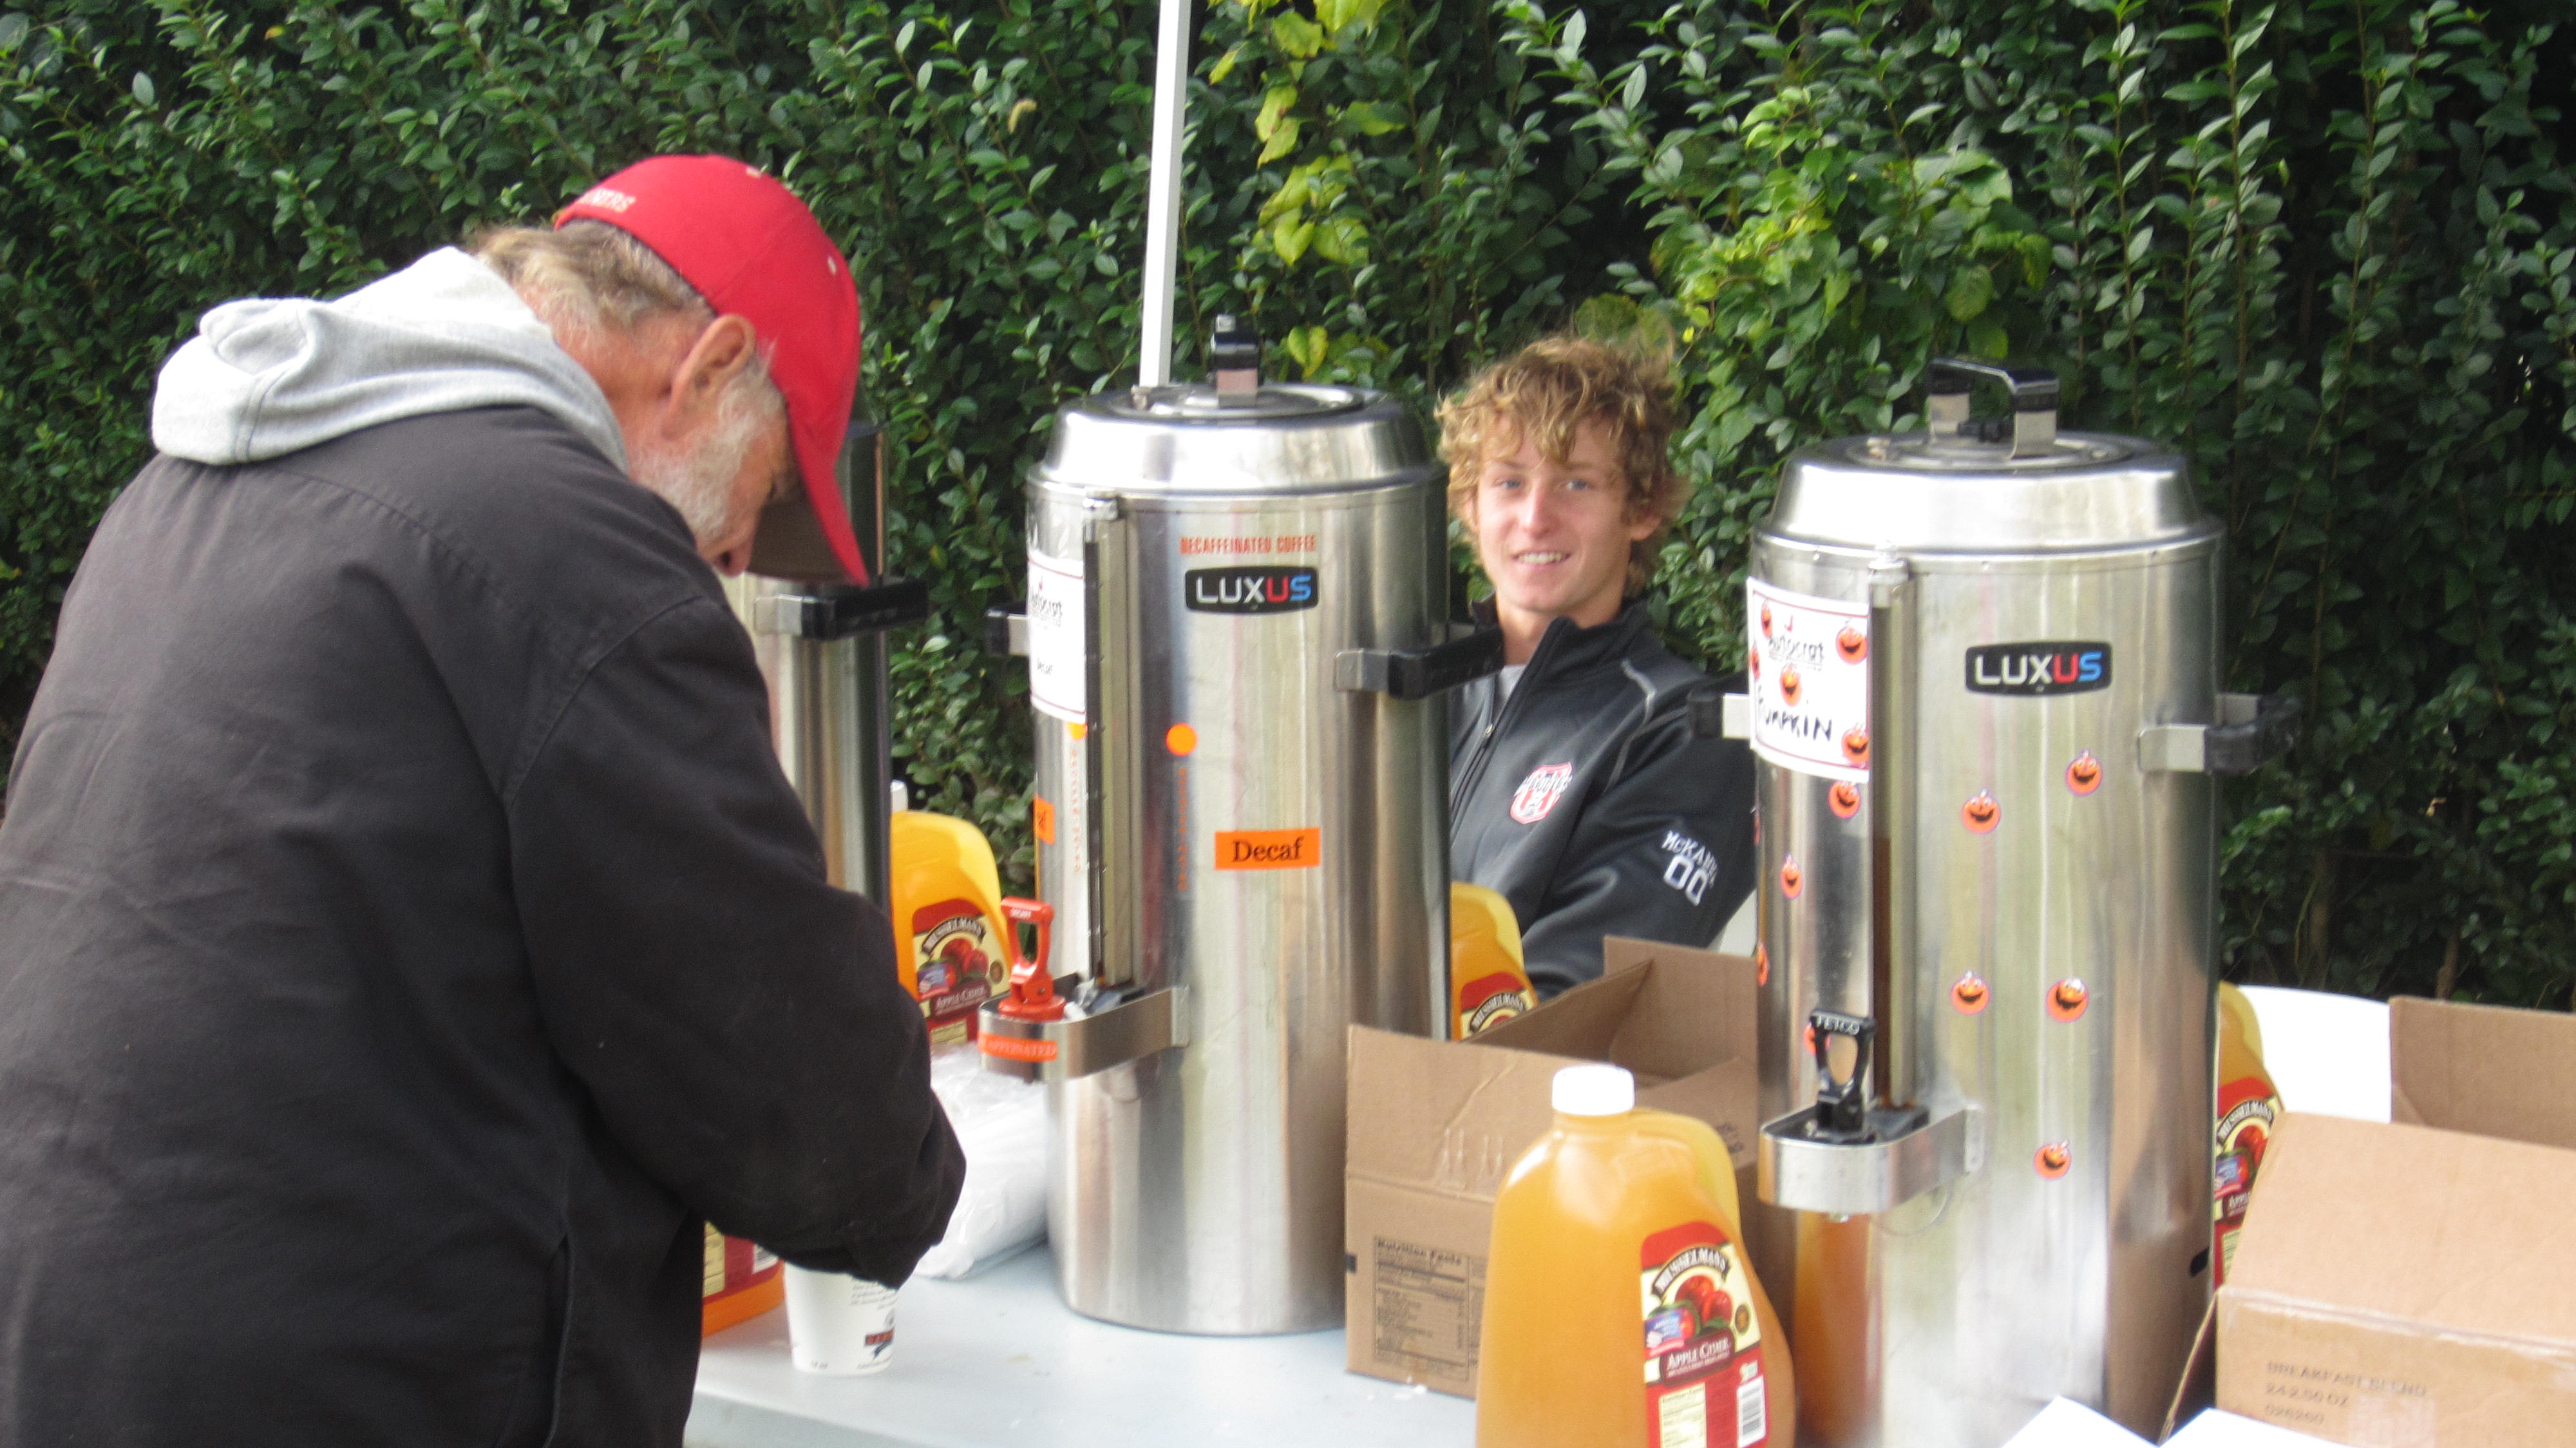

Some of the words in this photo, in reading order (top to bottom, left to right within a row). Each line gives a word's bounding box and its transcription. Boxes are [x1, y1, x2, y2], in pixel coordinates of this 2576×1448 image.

[1276, 534, 1316, 554] COFFEE
[1196, 574, 1312, 604] LUXUS
[1975, 651, 2104, 685] LUXUS
[1232, 835, 1304, 864] Decaf
[1663, 855, 1710, 906] 00
[1666, 1348, 1698, 1371] APPLE
[1698, 1336, 1730, 1360] CIDER
[2266, 1361, 2363, 1388] BREAKFAST
